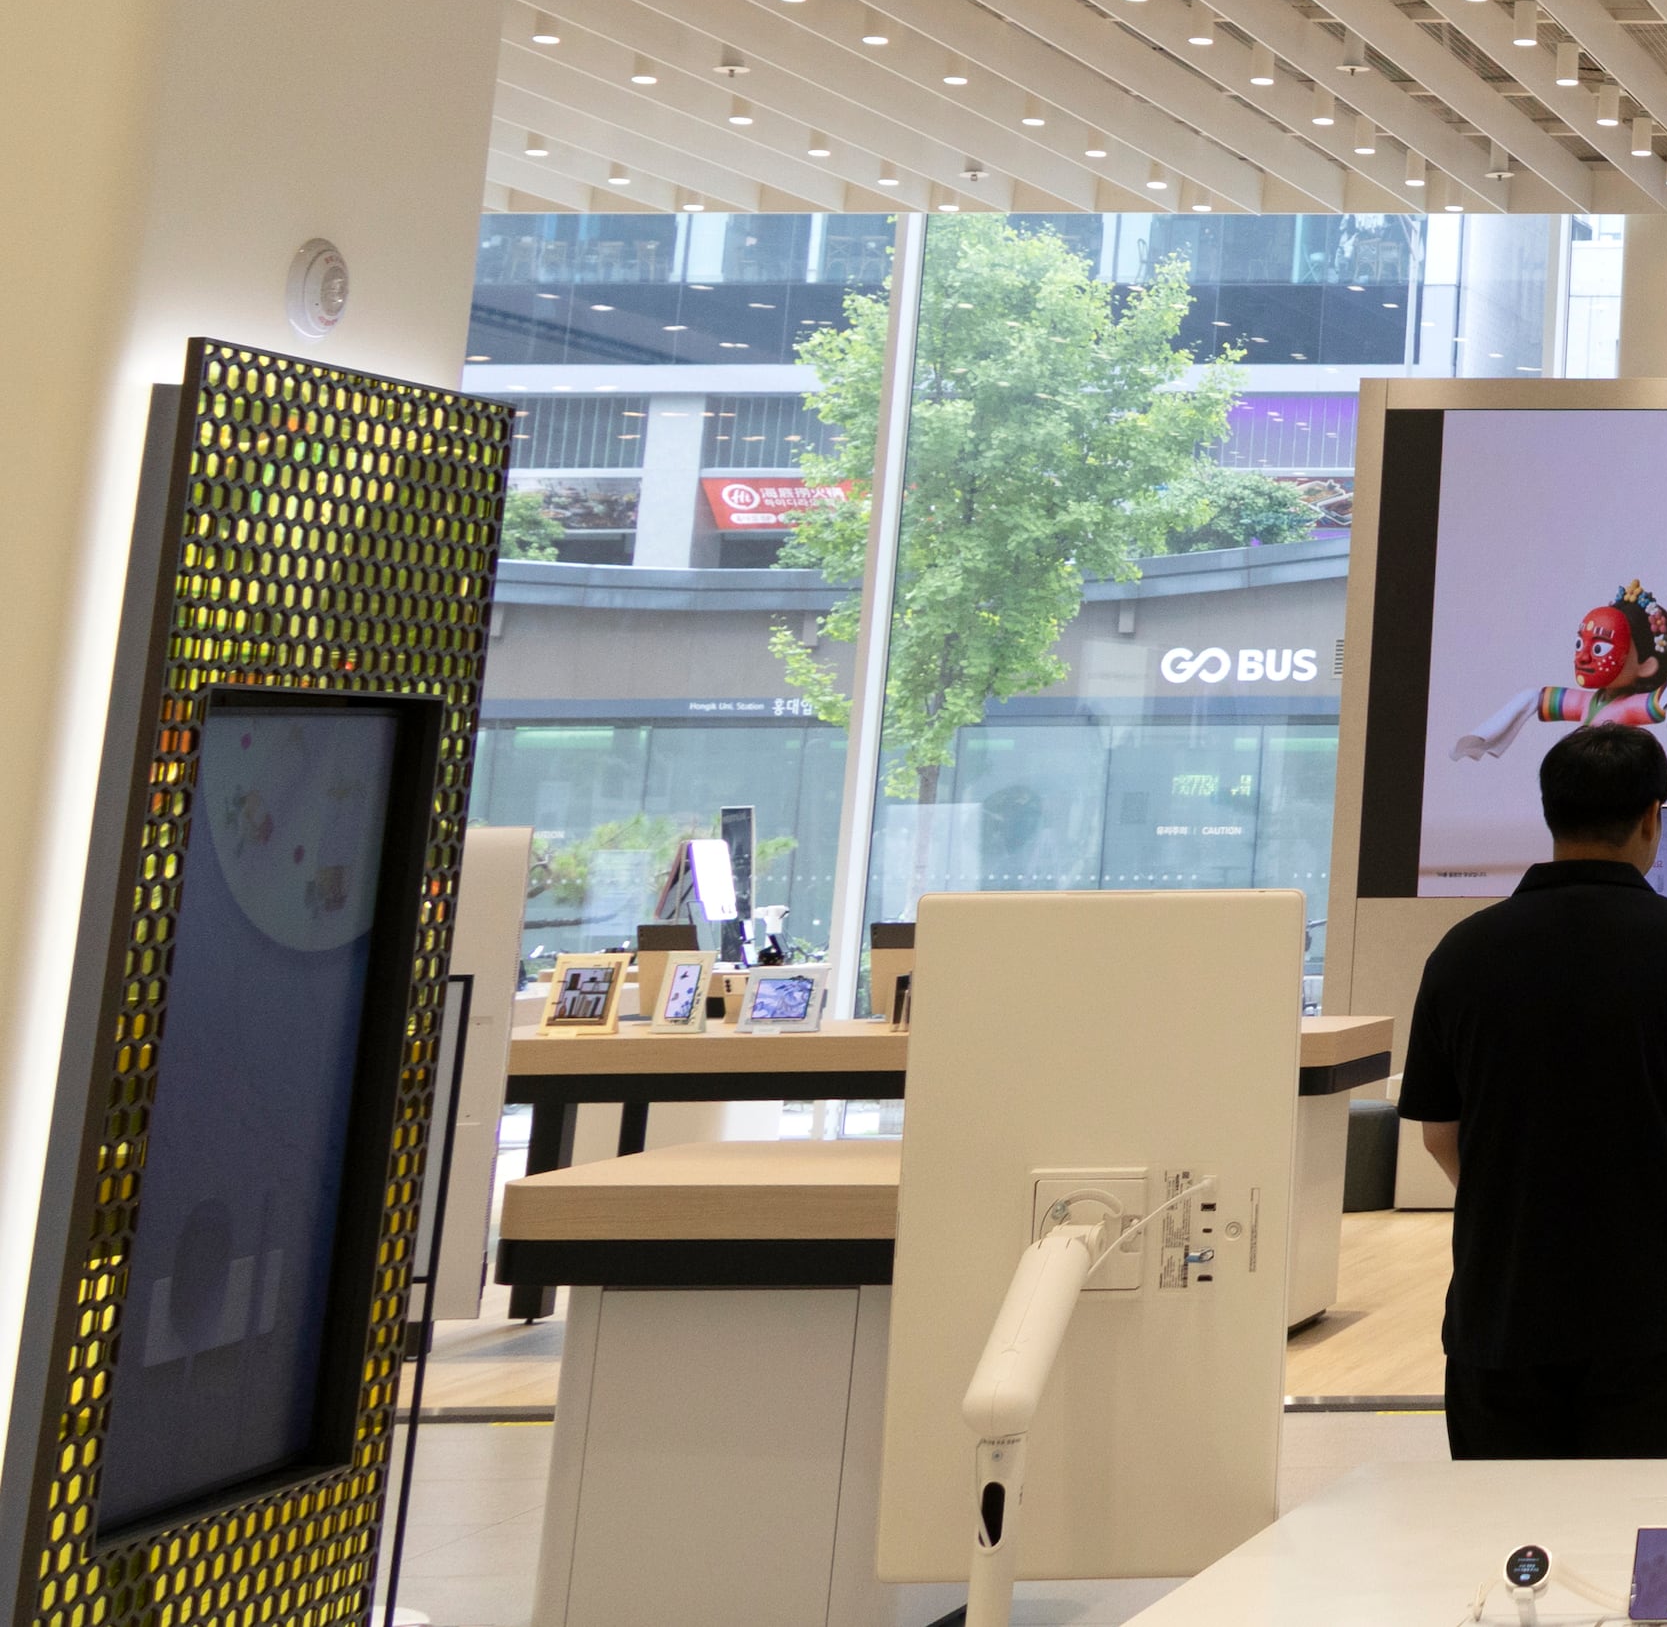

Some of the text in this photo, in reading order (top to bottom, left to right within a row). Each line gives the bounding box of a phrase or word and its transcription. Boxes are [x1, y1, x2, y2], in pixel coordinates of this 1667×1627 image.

[1161, 647, 1318, 683] GO BUS
[689, 702, 717, 712] Hongik
[736, 702, 765, 711] Station
[771, 698, 818, 716] 홍대입
[1202, 826, 1243, 835] CAUTION
